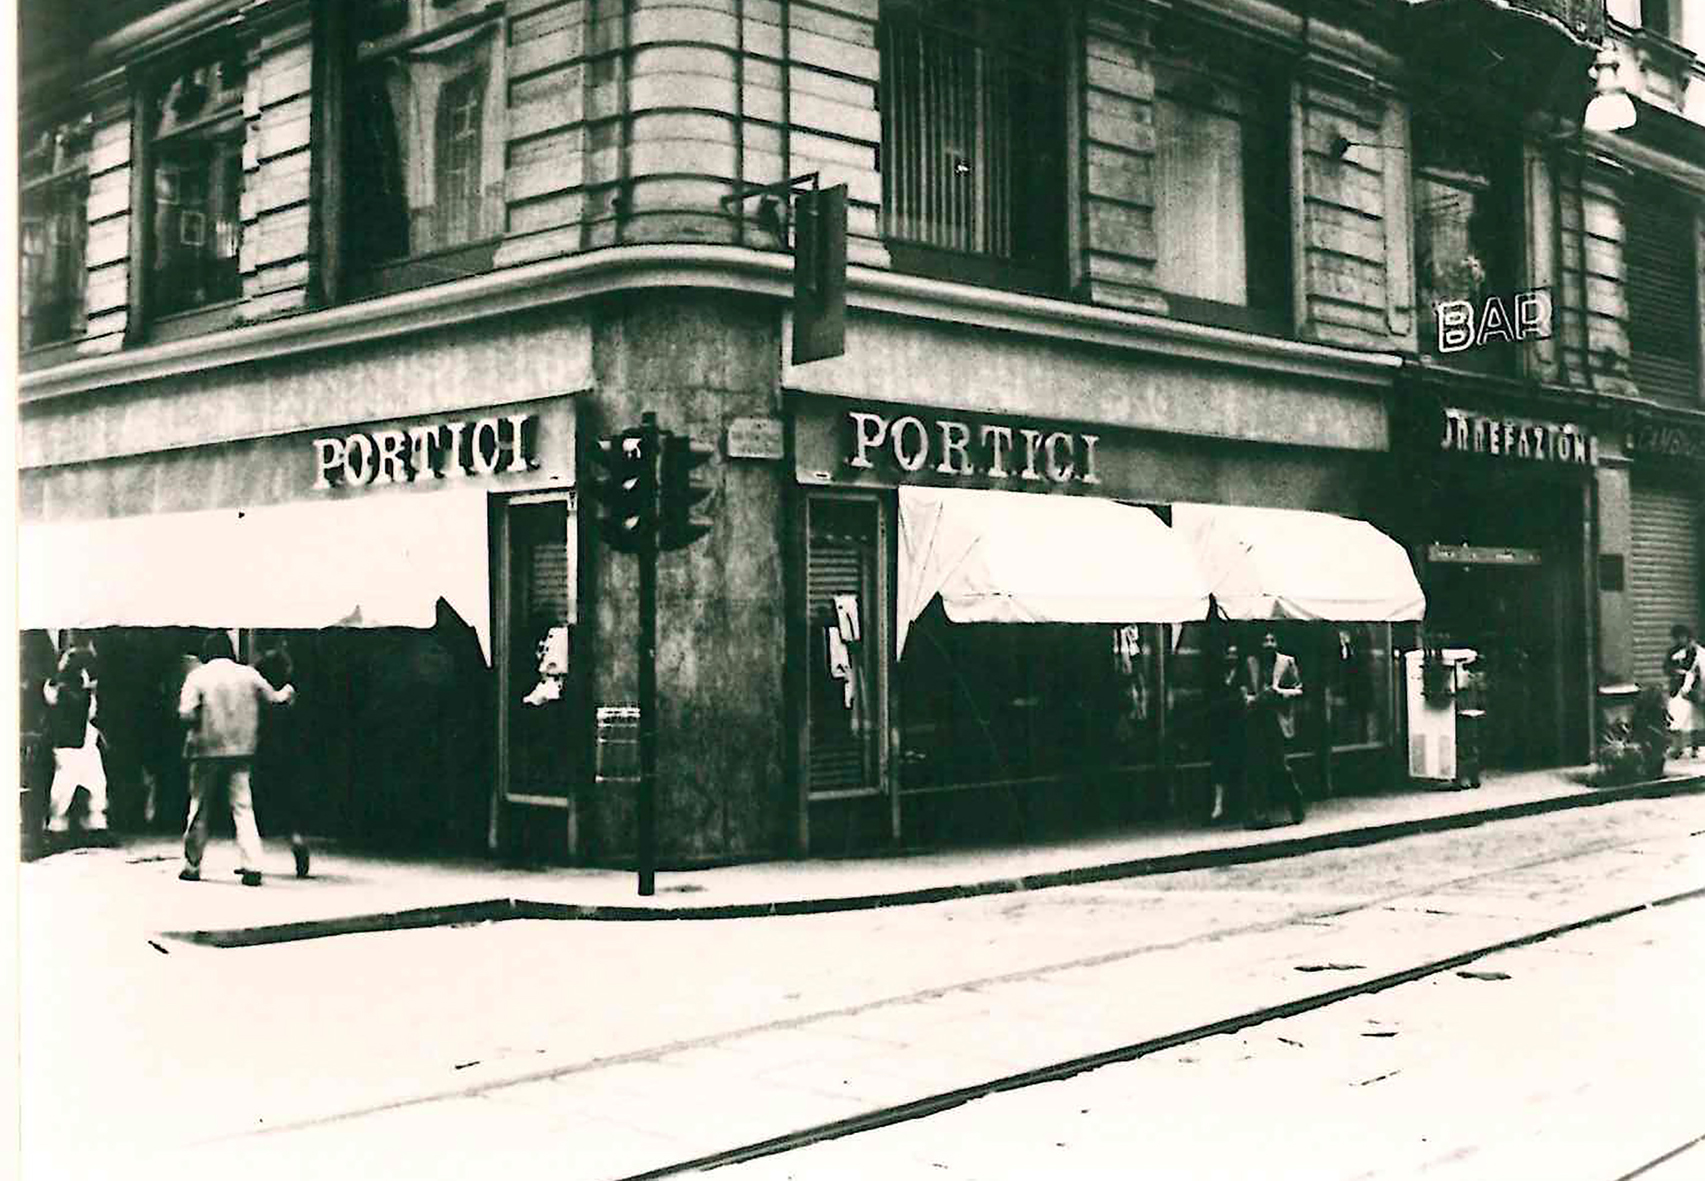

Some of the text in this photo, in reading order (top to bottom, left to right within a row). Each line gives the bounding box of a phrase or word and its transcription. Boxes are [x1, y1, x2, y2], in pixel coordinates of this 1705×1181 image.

[1437, 291, 1552, 353] BAR
[312, 414, 528, 490] PORTICI
[849, 411, 1100, 484] PORTICI
